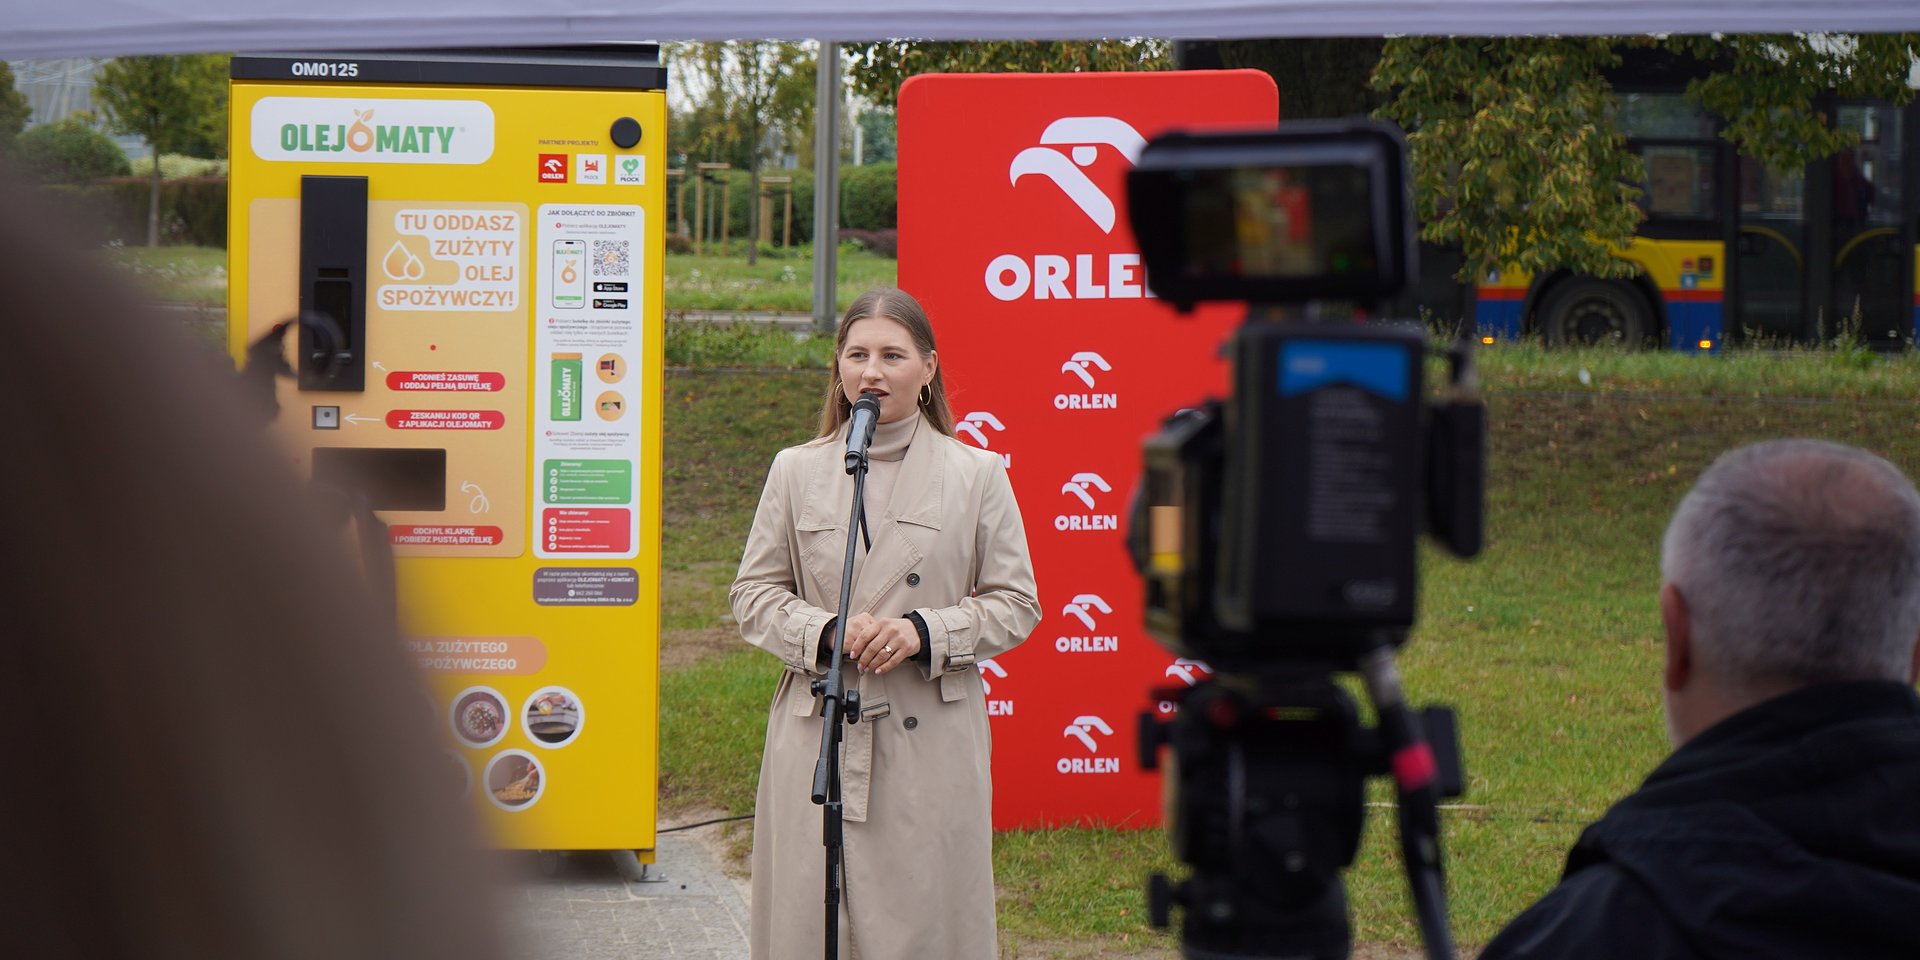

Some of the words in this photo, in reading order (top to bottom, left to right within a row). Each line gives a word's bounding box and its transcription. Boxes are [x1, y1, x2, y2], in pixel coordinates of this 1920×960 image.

[292, 62, 358, 77] OM0125
[280, 119, 455, 154] OLEJOMATY
[561, 209, 595, 217] DOŁĄCZYĆ
[400, 214, 427, 230] TU
[433, 215, 514, 231] ODDASZ
[434, 236, 514, 256] ZUŻYTY
[465, 266, 514, 282] OLEJ
[382, 286, 514, 307] SPOŻYWCZY!
[447, 374, 479, 382] ZASUWĘ
[431, 382, 456, 391] PEŁNĄ
[458, 383, 491, 391] BUTELKĘ
[1054, 394, 1117, 409] ORLEN
[1054, 515, 1117, 530] ORLEN
[445, 528, 475, 536] KLAPKĘ
[459, 537, 493, 545] BUTELKĘ
[437, 640, 508, 653] ZUŻYTEGO
[1055, 637, 1118, 652] ORLEN
[418, 656, 517, 670] SPOŻYWCZEGO
[1057, 758, 1119, 773] ORLEN
